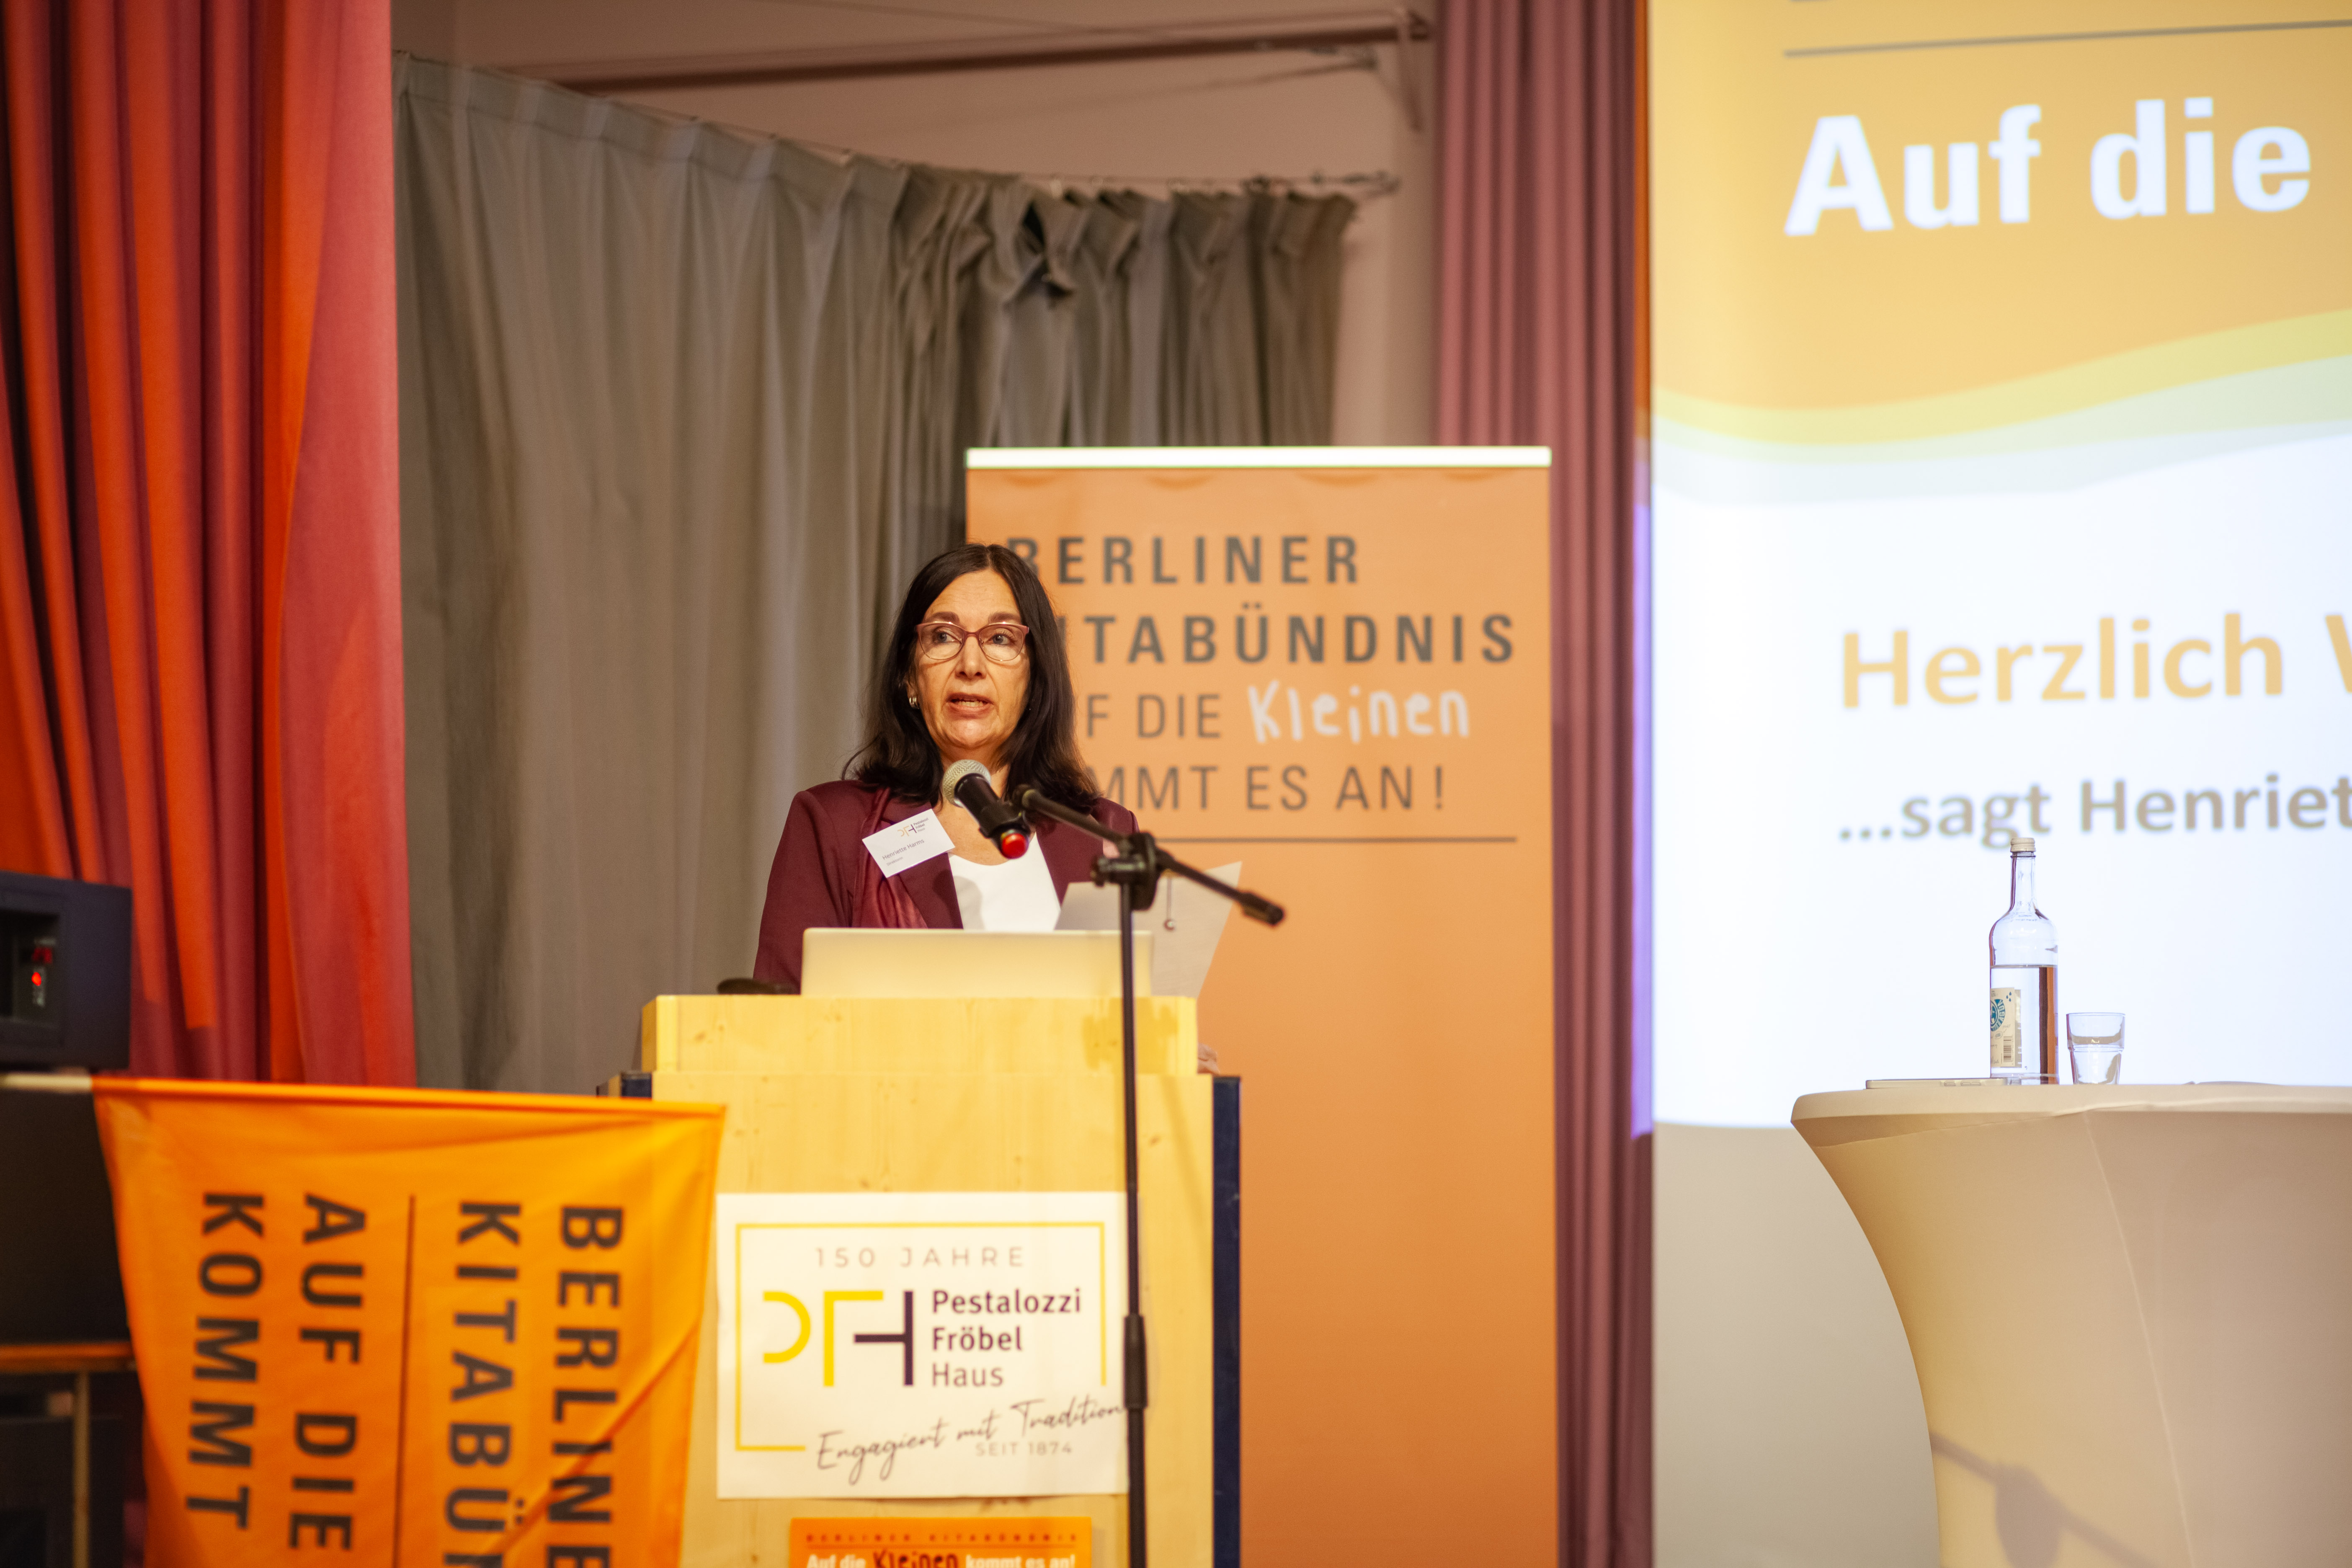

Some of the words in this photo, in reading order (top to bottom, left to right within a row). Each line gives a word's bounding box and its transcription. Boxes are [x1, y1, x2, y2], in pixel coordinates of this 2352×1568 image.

[1785, 104, 2042, 236] Auf
[2090, 97, 2311, 219] die
[1056, 603, 1514, 663] TABÜNDNIS
[1844, 613, 2282, 708] Herzlich
[1137, 694, 1220, 738] DIE
[1248, 679, 1469, 744] Kleinen
[1087, 765, 1218, 810] MMT
[1246, 765, 1308, 811] ES
[1839, 785, 2050, 849] ...sagt
[882, 846, 907, 860] Henriette
[907, 839, 924, 848] Harms
[300, 1194, 366, 1364] AUF
[816, 1246, 876, 1268] 150
[900, 1246, 1024, 1268] JAHRE
[932, 1287, 1081, 1314] Pestalozzi
[185, 1192, 265, 1529] KOMMT
[932, 1326, 1022, 1351] Fröbel
[932, 1362, 1003, 1387] Haus
[817, 1417, 949, 1485] Engagiert
[957, 1408, 1002, 1441] mit
[1010, 1393, 1124, 1437] Tradition
[976, 1441, 1018, 1456] SEIT
[1028, 1441, 1072, 1456] 1874
[288, 1412, 358, 1550] DIE
[873, 1548, 958, 1568] Kleinen
